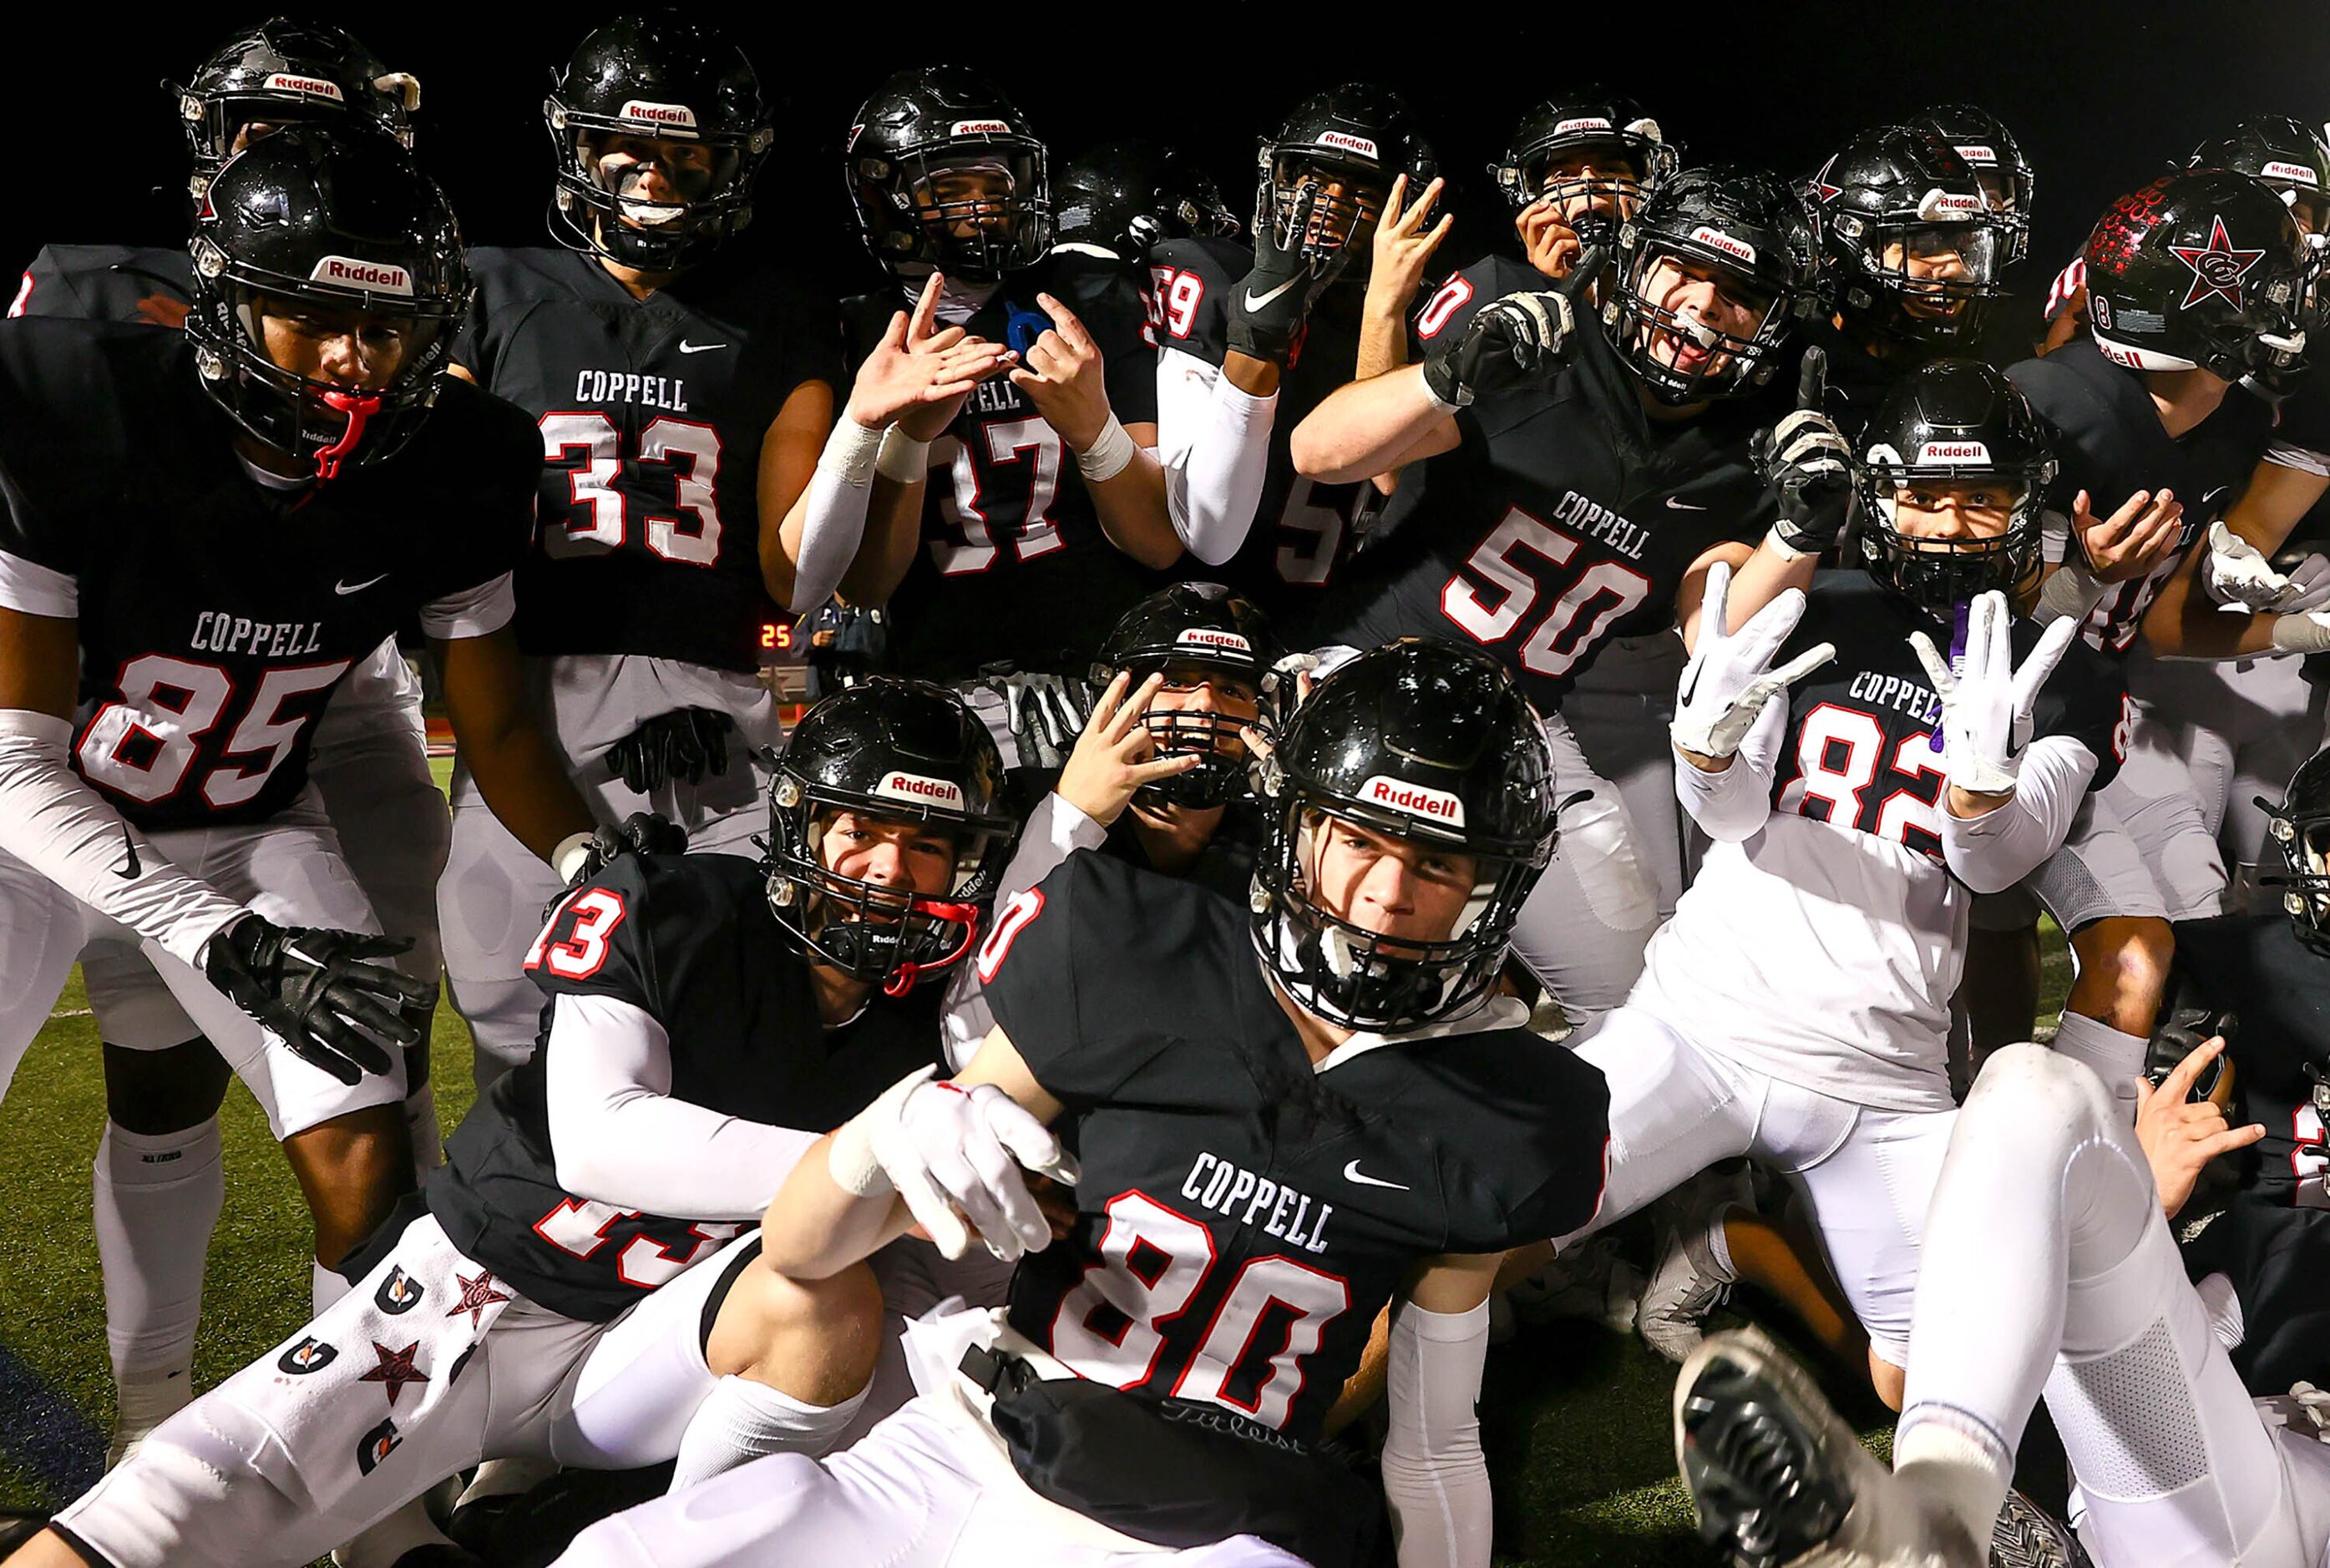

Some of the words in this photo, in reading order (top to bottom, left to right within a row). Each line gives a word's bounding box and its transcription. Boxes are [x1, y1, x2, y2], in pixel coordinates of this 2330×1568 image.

[275, 77, 334, 95] Riddell
[630, 106, 687, 123] Riddell
[1325, 134, 1373, 152] Riddell
[2271, 164, 2313, 179] Riddell
[1699, 230, 1751, 260] Riddell
[329, 260, 404, 287] Riddell
[576, 369, 689, 412] COPPELL
[1927, 446, 1982, 458] Riddell
[537, 410, 726, 570] 33
[1551, 489, 1651, 561] COPPELL
[1440, 503, 1653, 679] 50
[192, 610, 323, 657] COPPELL
[760, 624, 792, 648] 25
[1187, 631, 1246, 649] Riddell
[69, 651, 357, 810] 85
[892, 776, 958, 804] Riddell
[1372, 781, 1457, 818] Riddell
[523, 887, 626, 982] 13
[1178, 1151, 1333, 1252] COPPELL
[1050, 1187, 1353, 1431] 80
